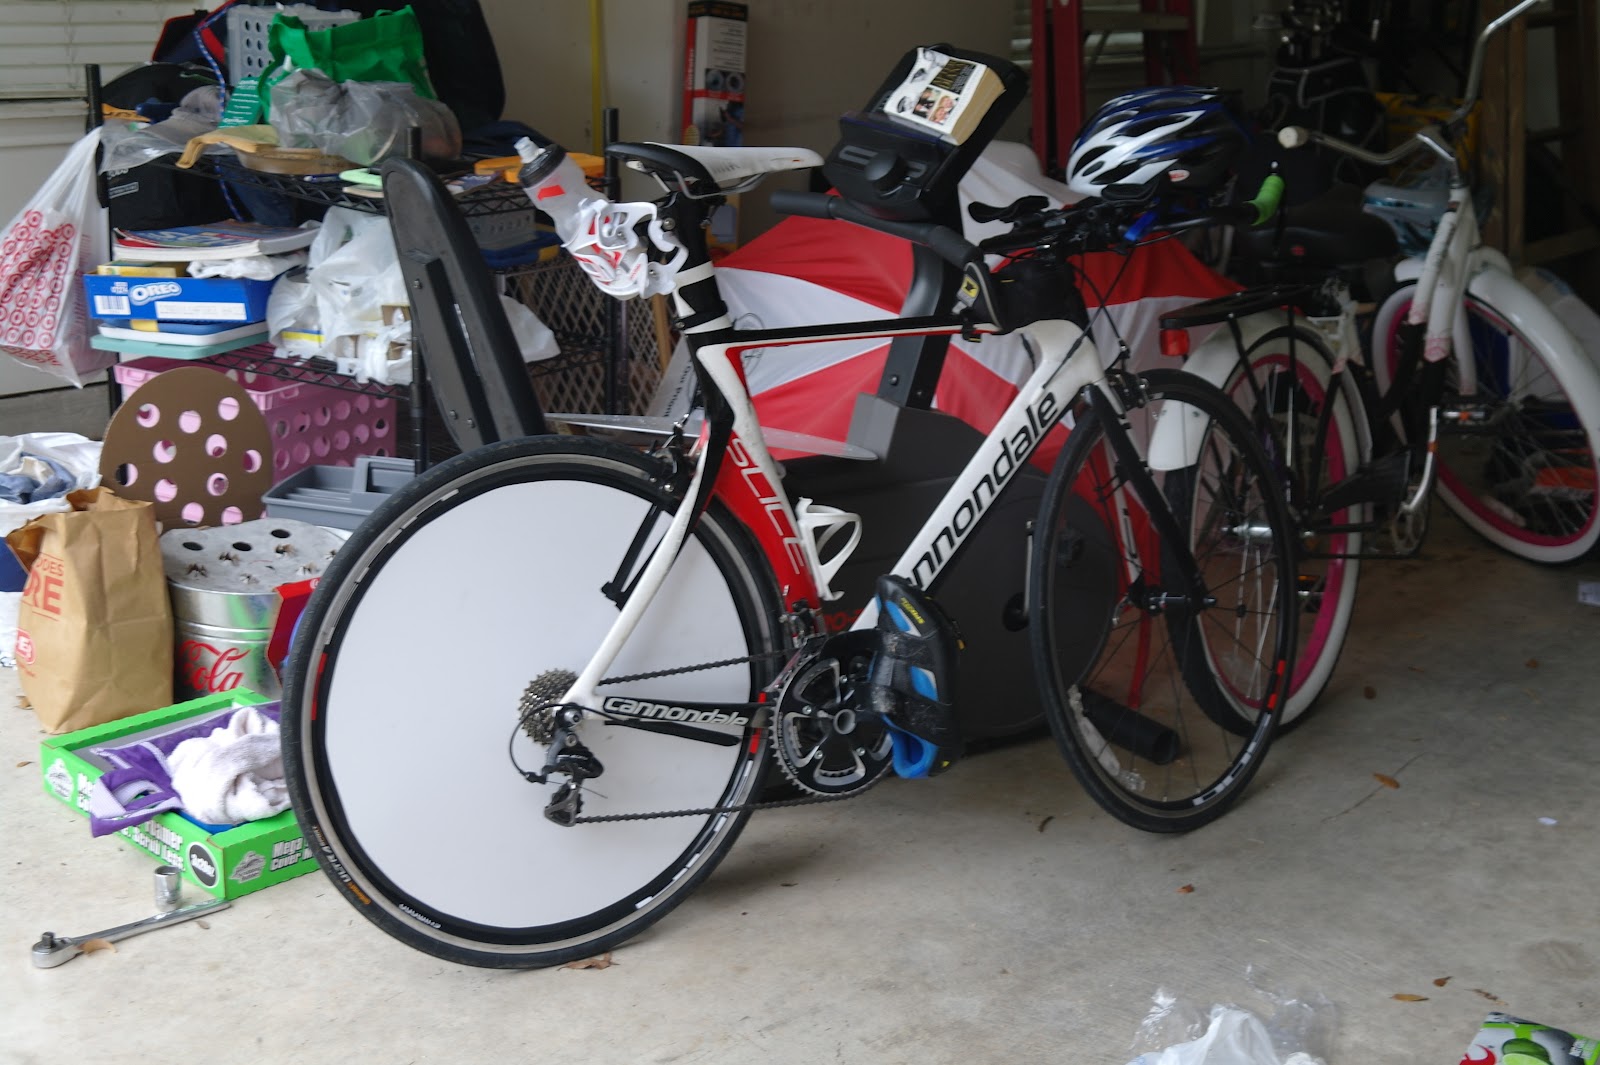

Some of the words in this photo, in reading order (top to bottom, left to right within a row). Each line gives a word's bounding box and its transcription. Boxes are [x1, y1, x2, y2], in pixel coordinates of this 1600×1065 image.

[132, 283, 180, 301] OREO
[906, 391, 1059, 588] nnondale
[728, 438, 805, 575] SLICE
[604, 697, 749, 726] cannondale
[269, 852, 302, 872] Cover
[272, 837, 303, 860] Mega
[321, 845, 352, 883] ULTRA
